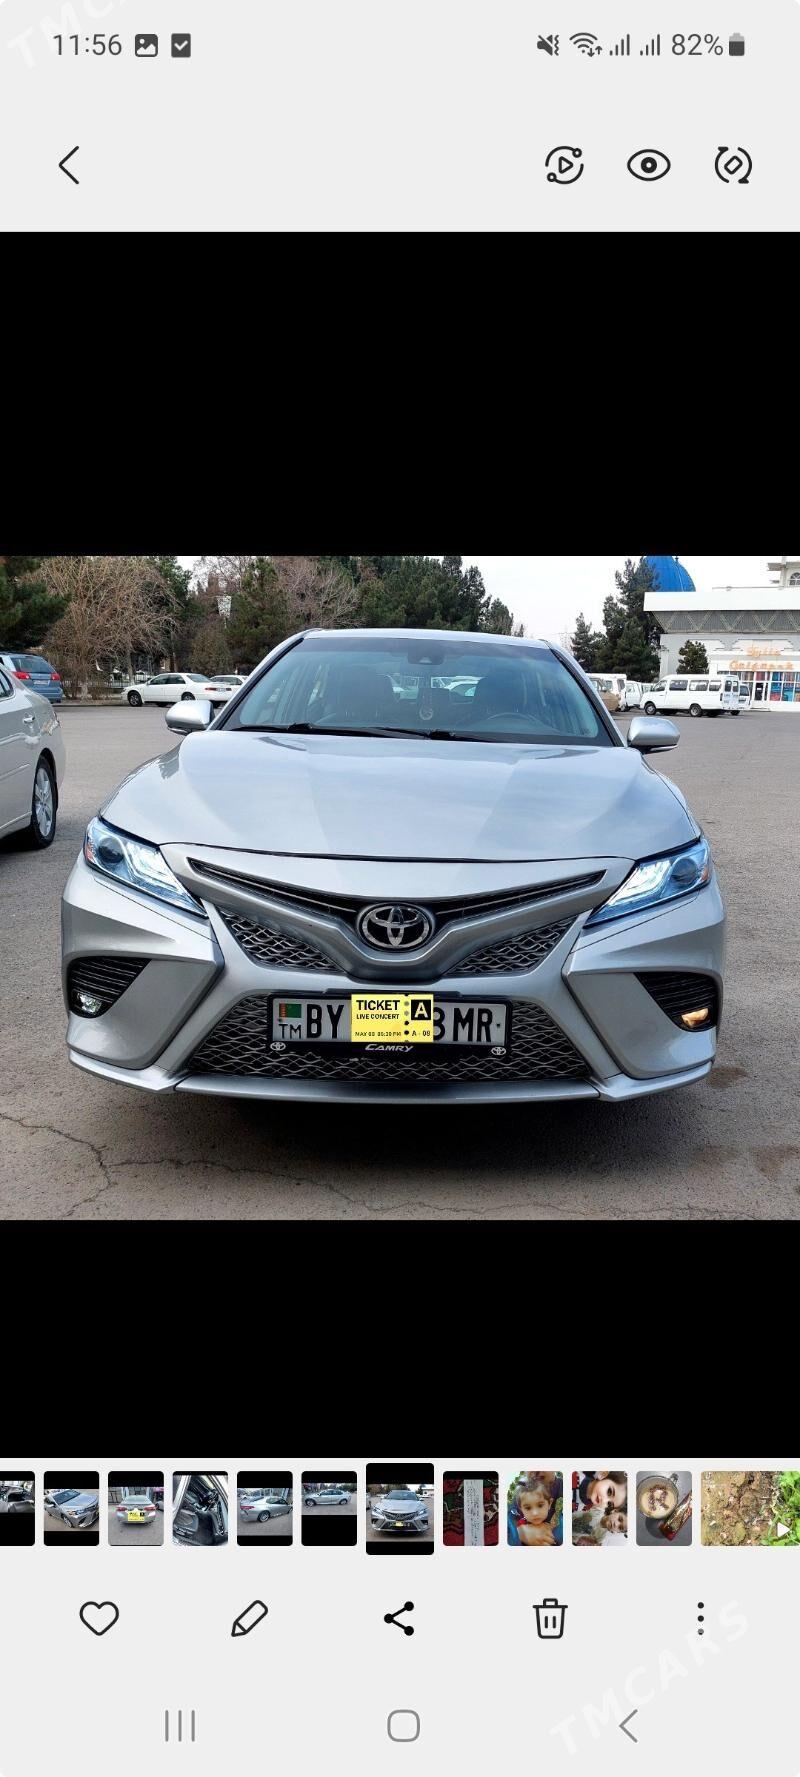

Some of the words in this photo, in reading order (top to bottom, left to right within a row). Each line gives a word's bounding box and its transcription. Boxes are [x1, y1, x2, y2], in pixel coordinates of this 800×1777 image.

[53, 33, 122, 56] 11:56
[671, 33, 724, 56] 82%
[278, 1023, 302, 1039] TM
[306, 1004, 344, 1039] BY
[453, 1008, 493, 1042] MR
[364, 1043, 414, 1052] CAMRY
